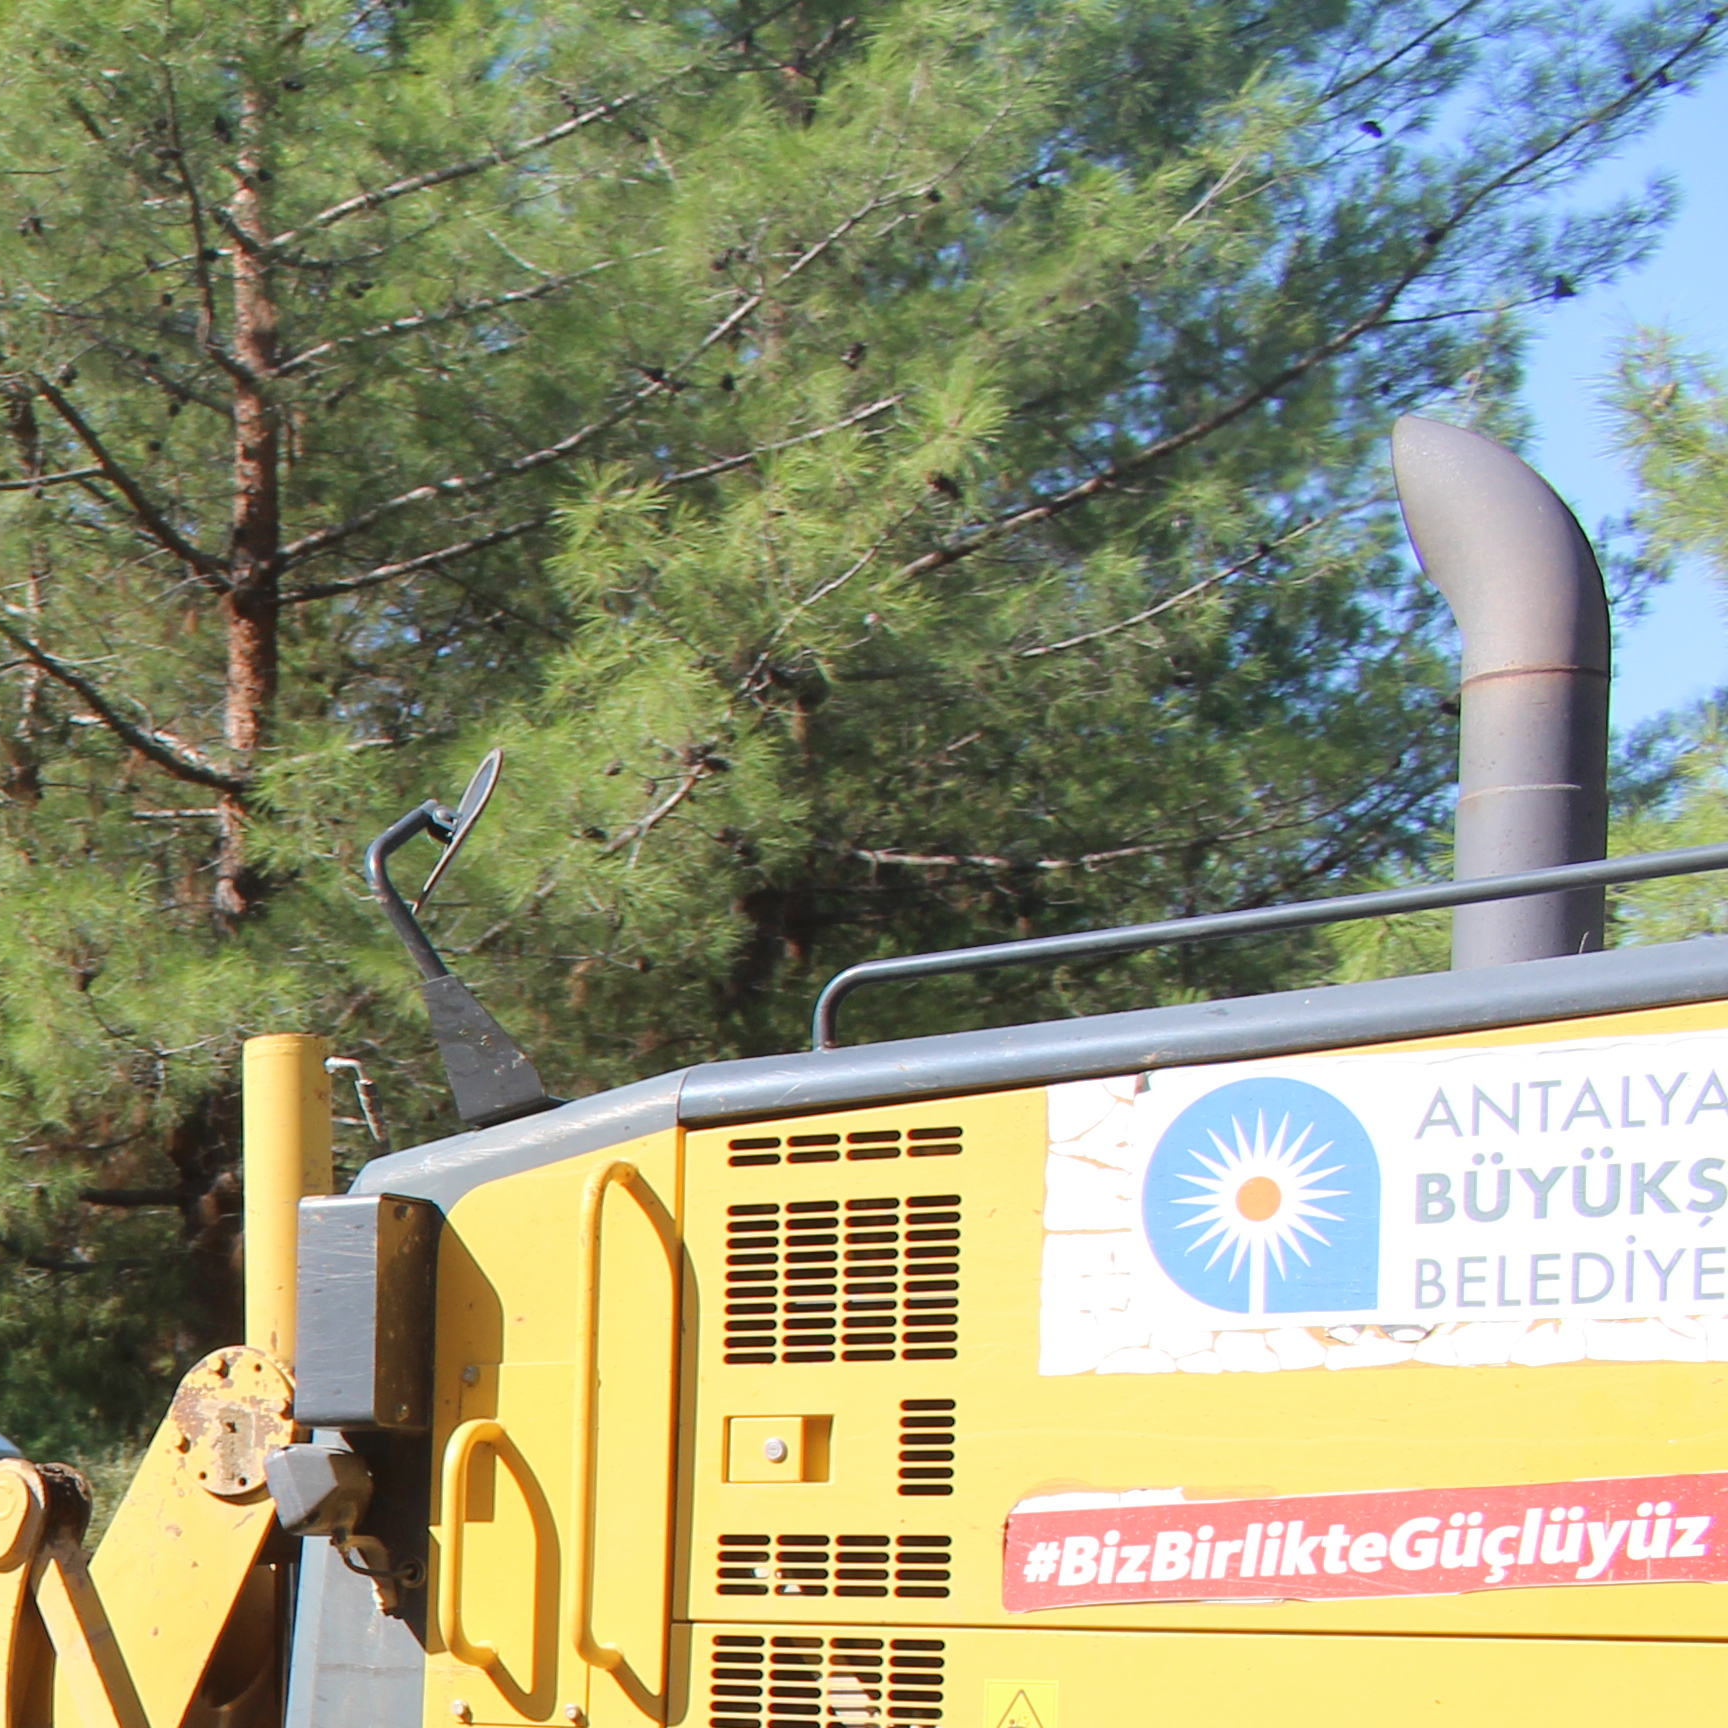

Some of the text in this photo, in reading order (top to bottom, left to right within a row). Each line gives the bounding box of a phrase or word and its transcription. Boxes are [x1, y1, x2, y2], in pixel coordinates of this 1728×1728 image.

[1414, 1068, 1728, 1140] ANTALYA
[1415, 1146, 1728, 1228] BÜYÜKŞ
[1414, 1235, 1727, 1309] BELEDİYE
[1023, 1501, 1712, 1587] #BizBirlikteGüçlüyüz
